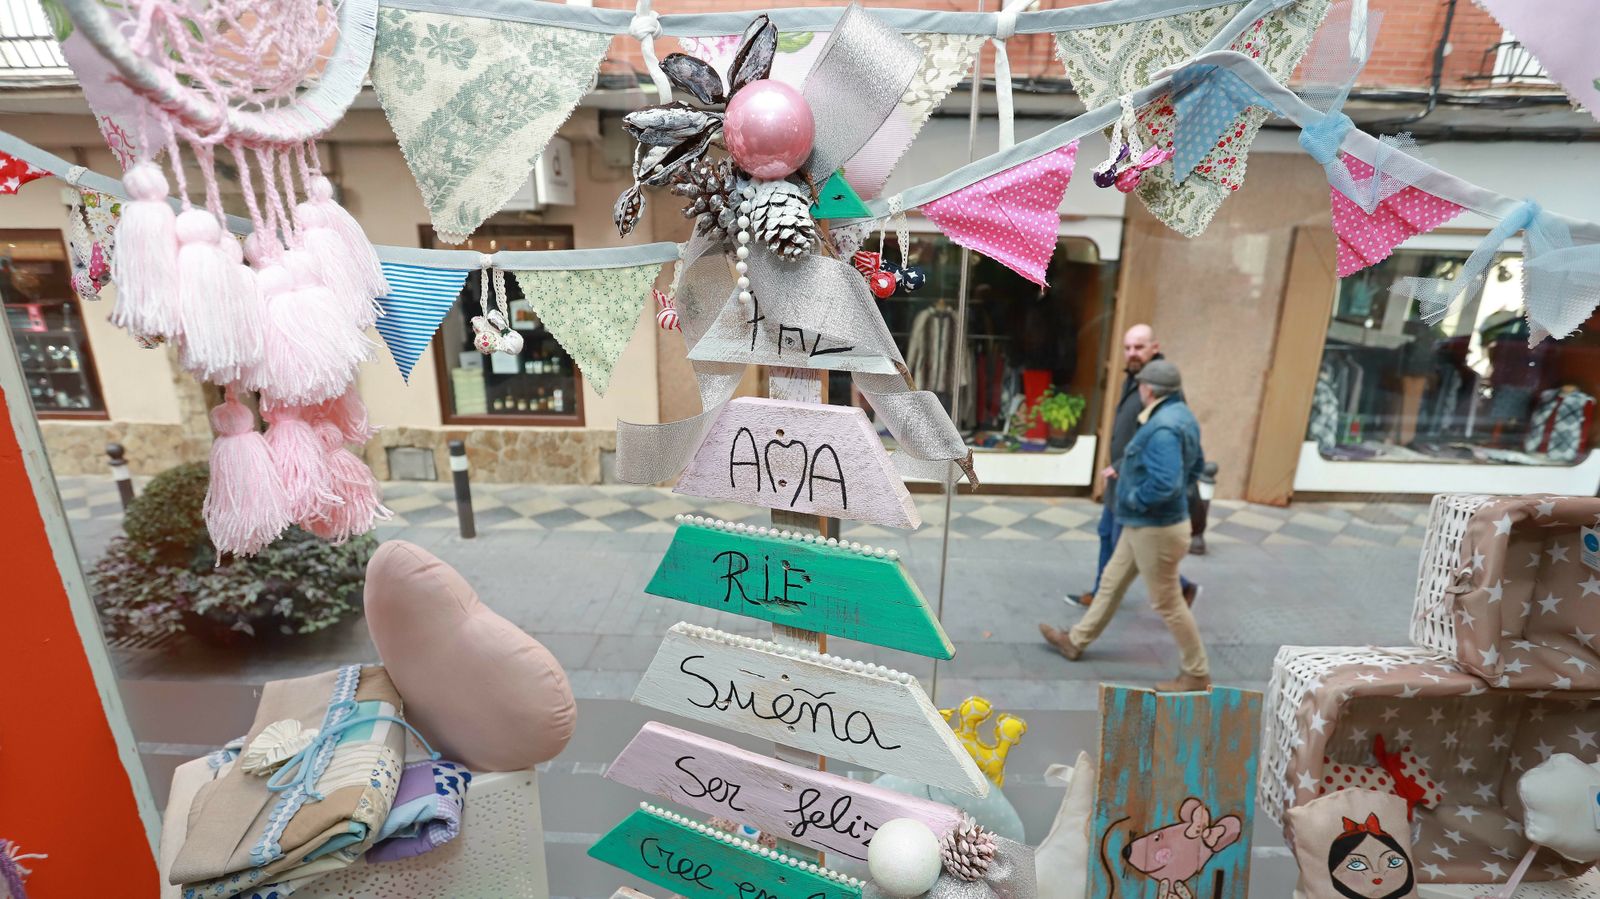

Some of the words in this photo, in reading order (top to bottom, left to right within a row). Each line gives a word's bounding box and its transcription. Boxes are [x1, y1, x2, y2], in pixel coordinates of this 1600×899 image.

[730, 427, 848, 510] AMA
[680, 656, 901, 750] Sueña
[674, 756, 745, 812] Ser
